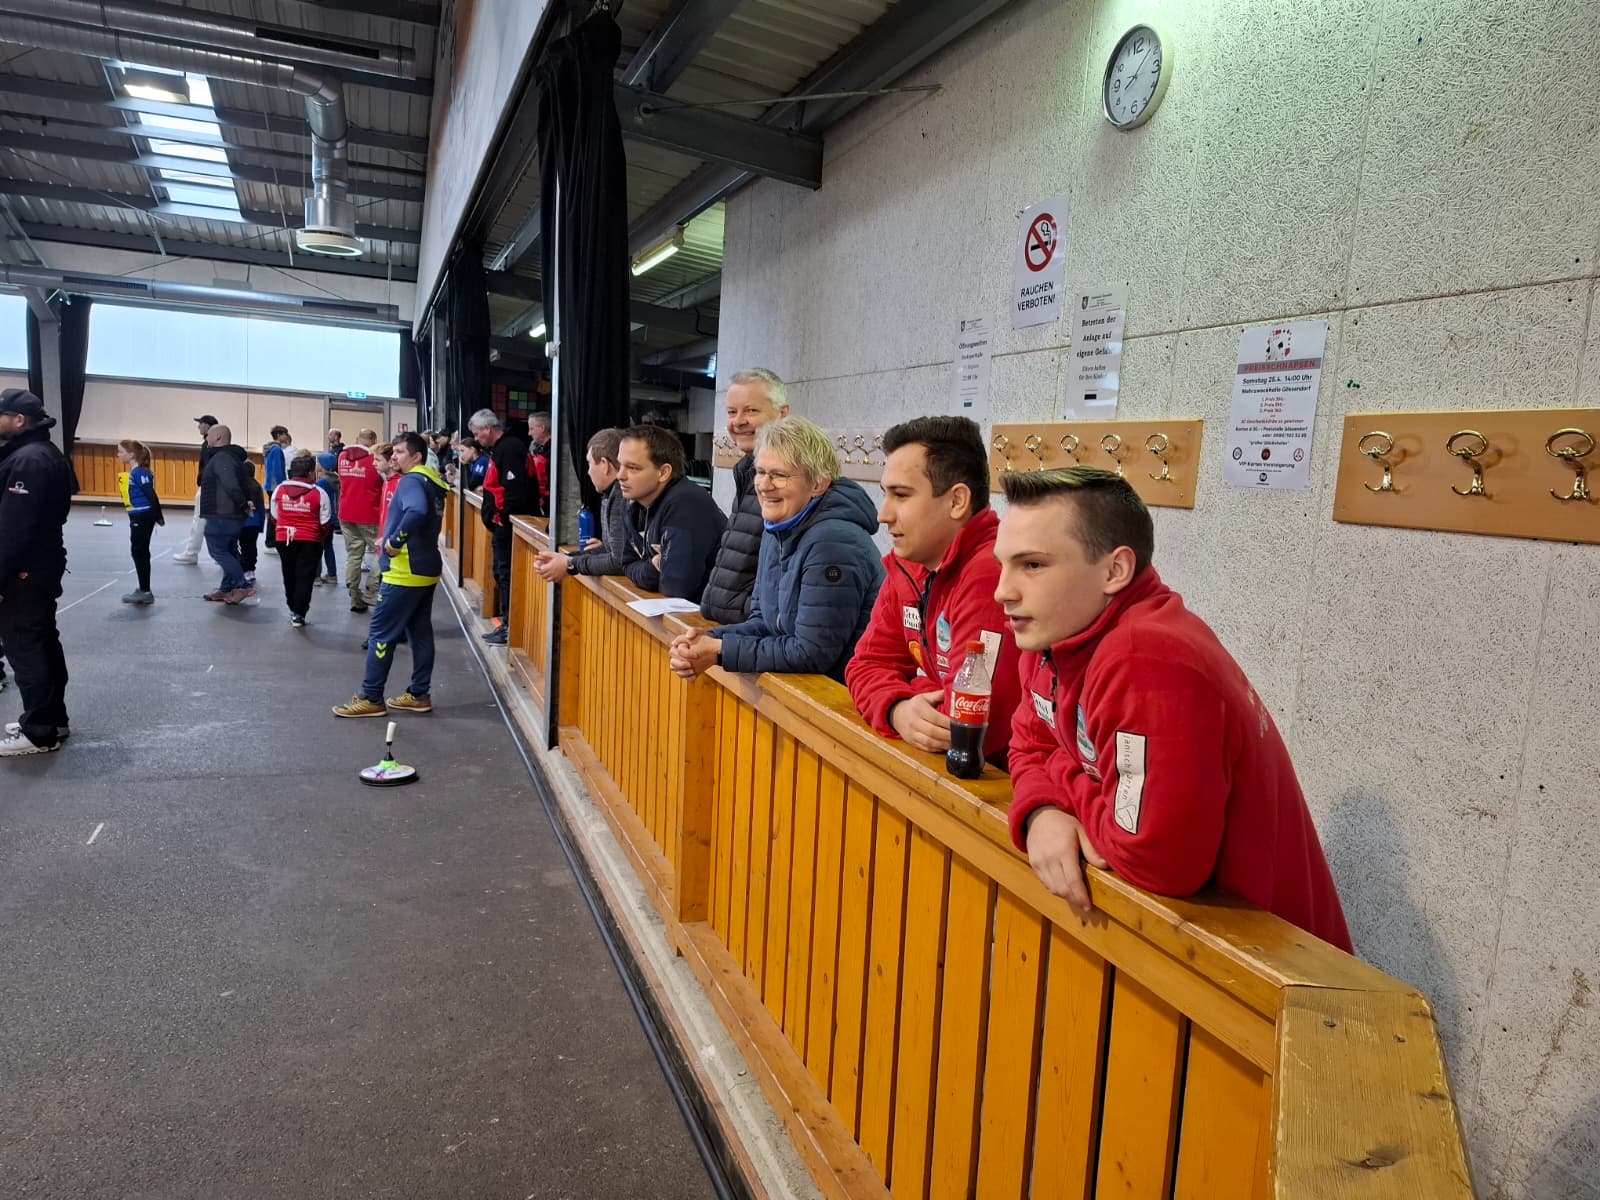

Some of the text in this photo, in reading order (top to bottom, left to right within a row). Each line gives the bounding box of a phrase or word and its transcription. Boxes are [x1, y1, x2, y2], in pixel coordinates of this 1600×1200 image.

[1133, 36, 1145, 55] 12
[1151, 59, 1160, 74] 3
[1113, 79, 1121, 93] 9
[1116, 97, 1121, 106] 8
[1130, 100, 1138, 114] 6
[1020, 281, 1054, 298] RAUCHEN
[1017, 293, 1056, 312] VERBOTEN!
[1082, 334, 1101, 342] Anlage
[1076, 349, 1093, 359] eigene
[1242, 377, 1268, 385] Samstag
[955, 696, 990, 712] Coca-Cola
